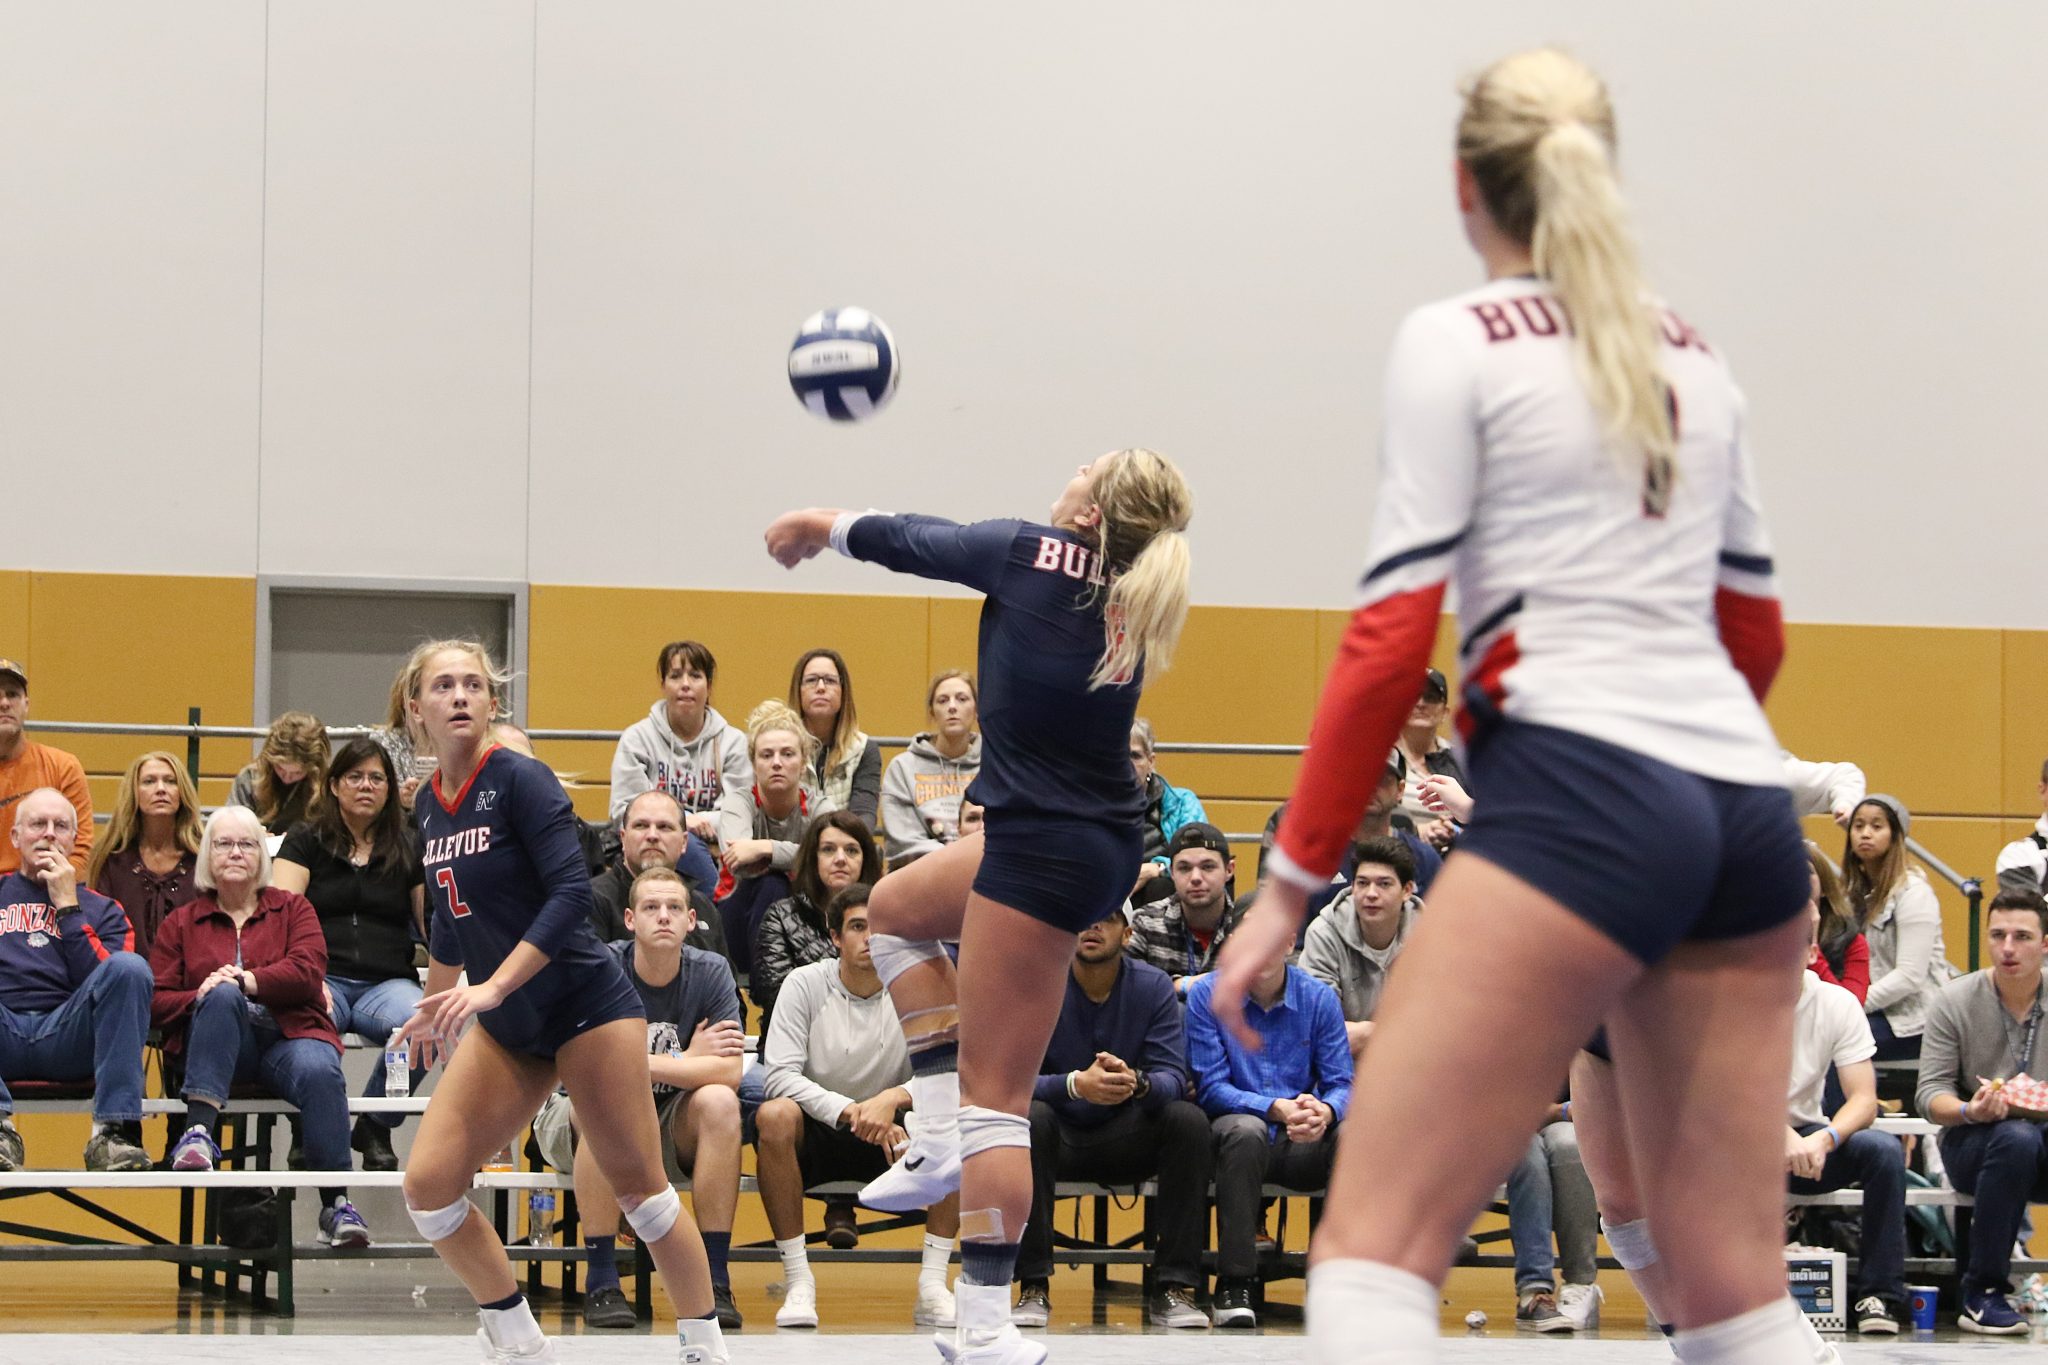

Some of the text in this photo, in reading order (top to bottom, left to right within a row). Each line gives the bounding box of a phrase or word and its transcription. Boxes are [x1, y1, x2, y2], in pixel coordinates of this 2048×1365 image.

[1033, 536, 1112, 586] BUL
[422, 826, 491, 867] LLEVUE
[0, 902, 62, 940] GONZA
